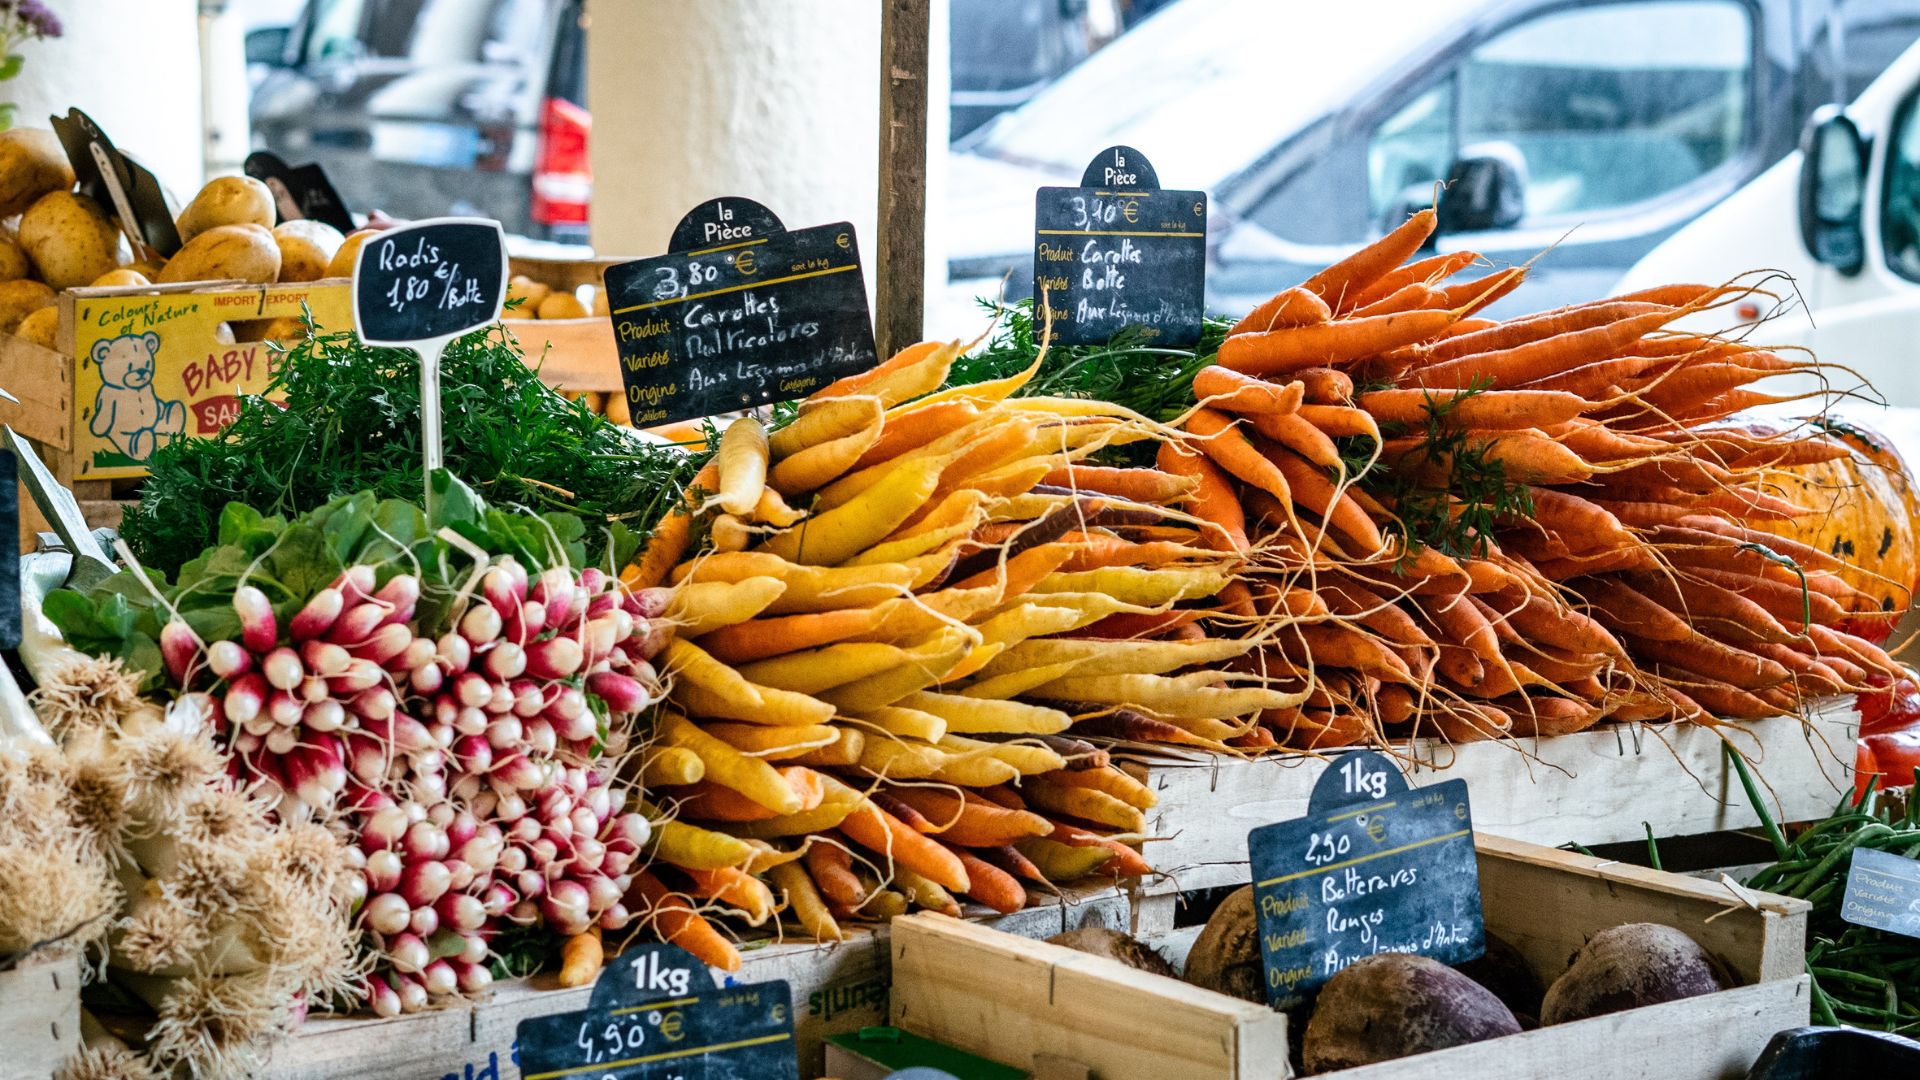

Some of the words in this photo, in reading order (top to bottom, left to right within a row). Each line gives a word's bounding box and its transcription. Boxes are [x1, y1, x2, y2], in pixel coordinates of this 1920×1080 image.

[1115, 149, 1125, 168] la
[1105, 167, 1137, 186] Pièce
[718, 202, 733, 221] la
[704, 222, 752, 242] Pièce
[379, 236, 440, 271] Radis
[1038, 242, 1073, 263] Produit
[1081, 238, 1142, 264] Carottes
[653, 262, 719, 299] 3,80
[1082, 264, 1125, 290] Botte
[213, 295, 256, 307] IMPORT
[265, 293, 309, 305] EXPORT
[386, 276, 430, 312] 1,80
[99, 300, 160, 327] Colours
[120, 319, 135, 335] of
[143, 303, 199, 327] Nature
[684, 291, 780, 328] Carottes
[618, 318, 671, 342] Produit
[182, 347, 256, 397] BABY
[623, 349, 670, 372] Variété
[689, 367, 727, 391] Aux
[630, 383, 677, 406] Origine
[1340, 758, 1387, 799] 1kg
[1304, 833, 1351, 866] 2,90
[1261, 891, 1309, 919] Produit
[630, 951, 691, 997] 1kg
[578, 1022, 645, 1063] 4,90
